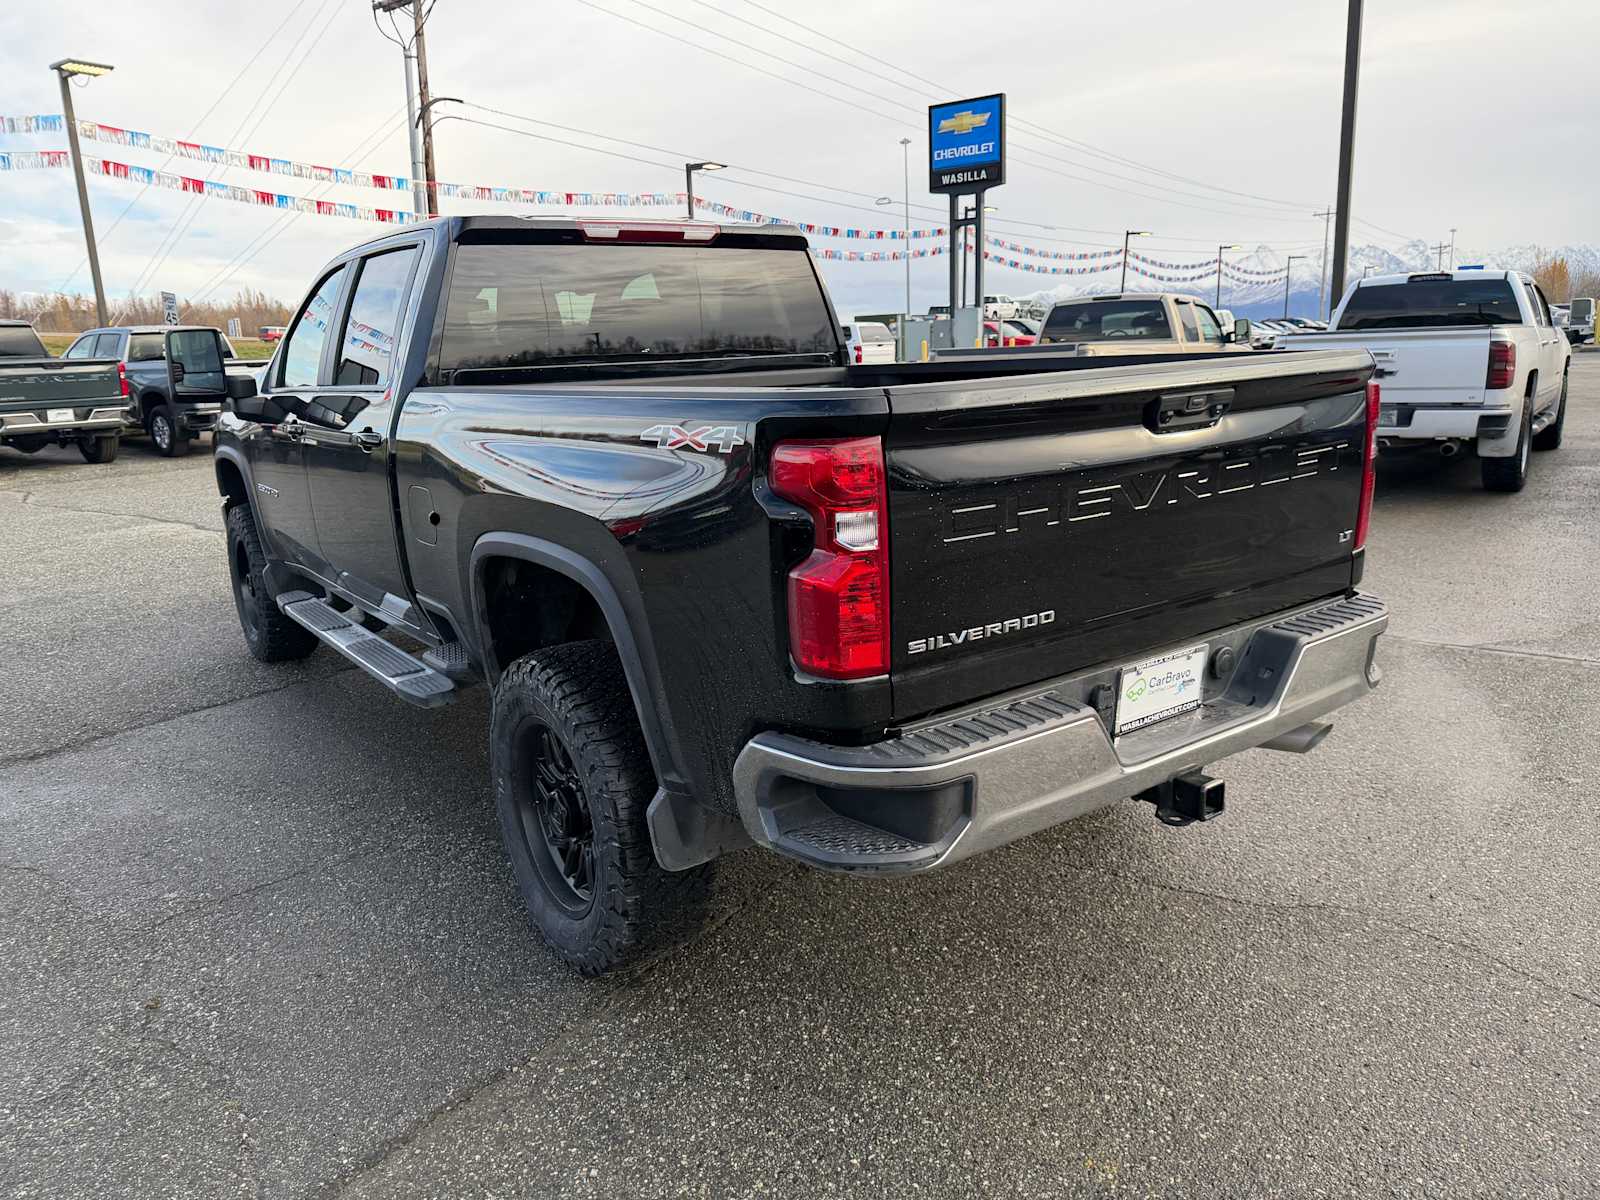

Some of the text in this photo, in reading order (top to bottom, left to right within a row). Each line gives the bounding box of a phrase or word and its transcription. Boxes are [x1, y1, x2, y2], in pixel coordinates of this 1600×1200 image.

[934, 142, 995, 161] CHEVROLET
[942, 169, 987, 185] WASILLA
[165, 311, 178, 326] 45
[943, 441, 1349, 543] CHEVROLET
[1339, 529, 1353, 543] LT
[907, 609, 1056, 655] SILVERADO
[1149, 669, 1191, 688] CarBravo
